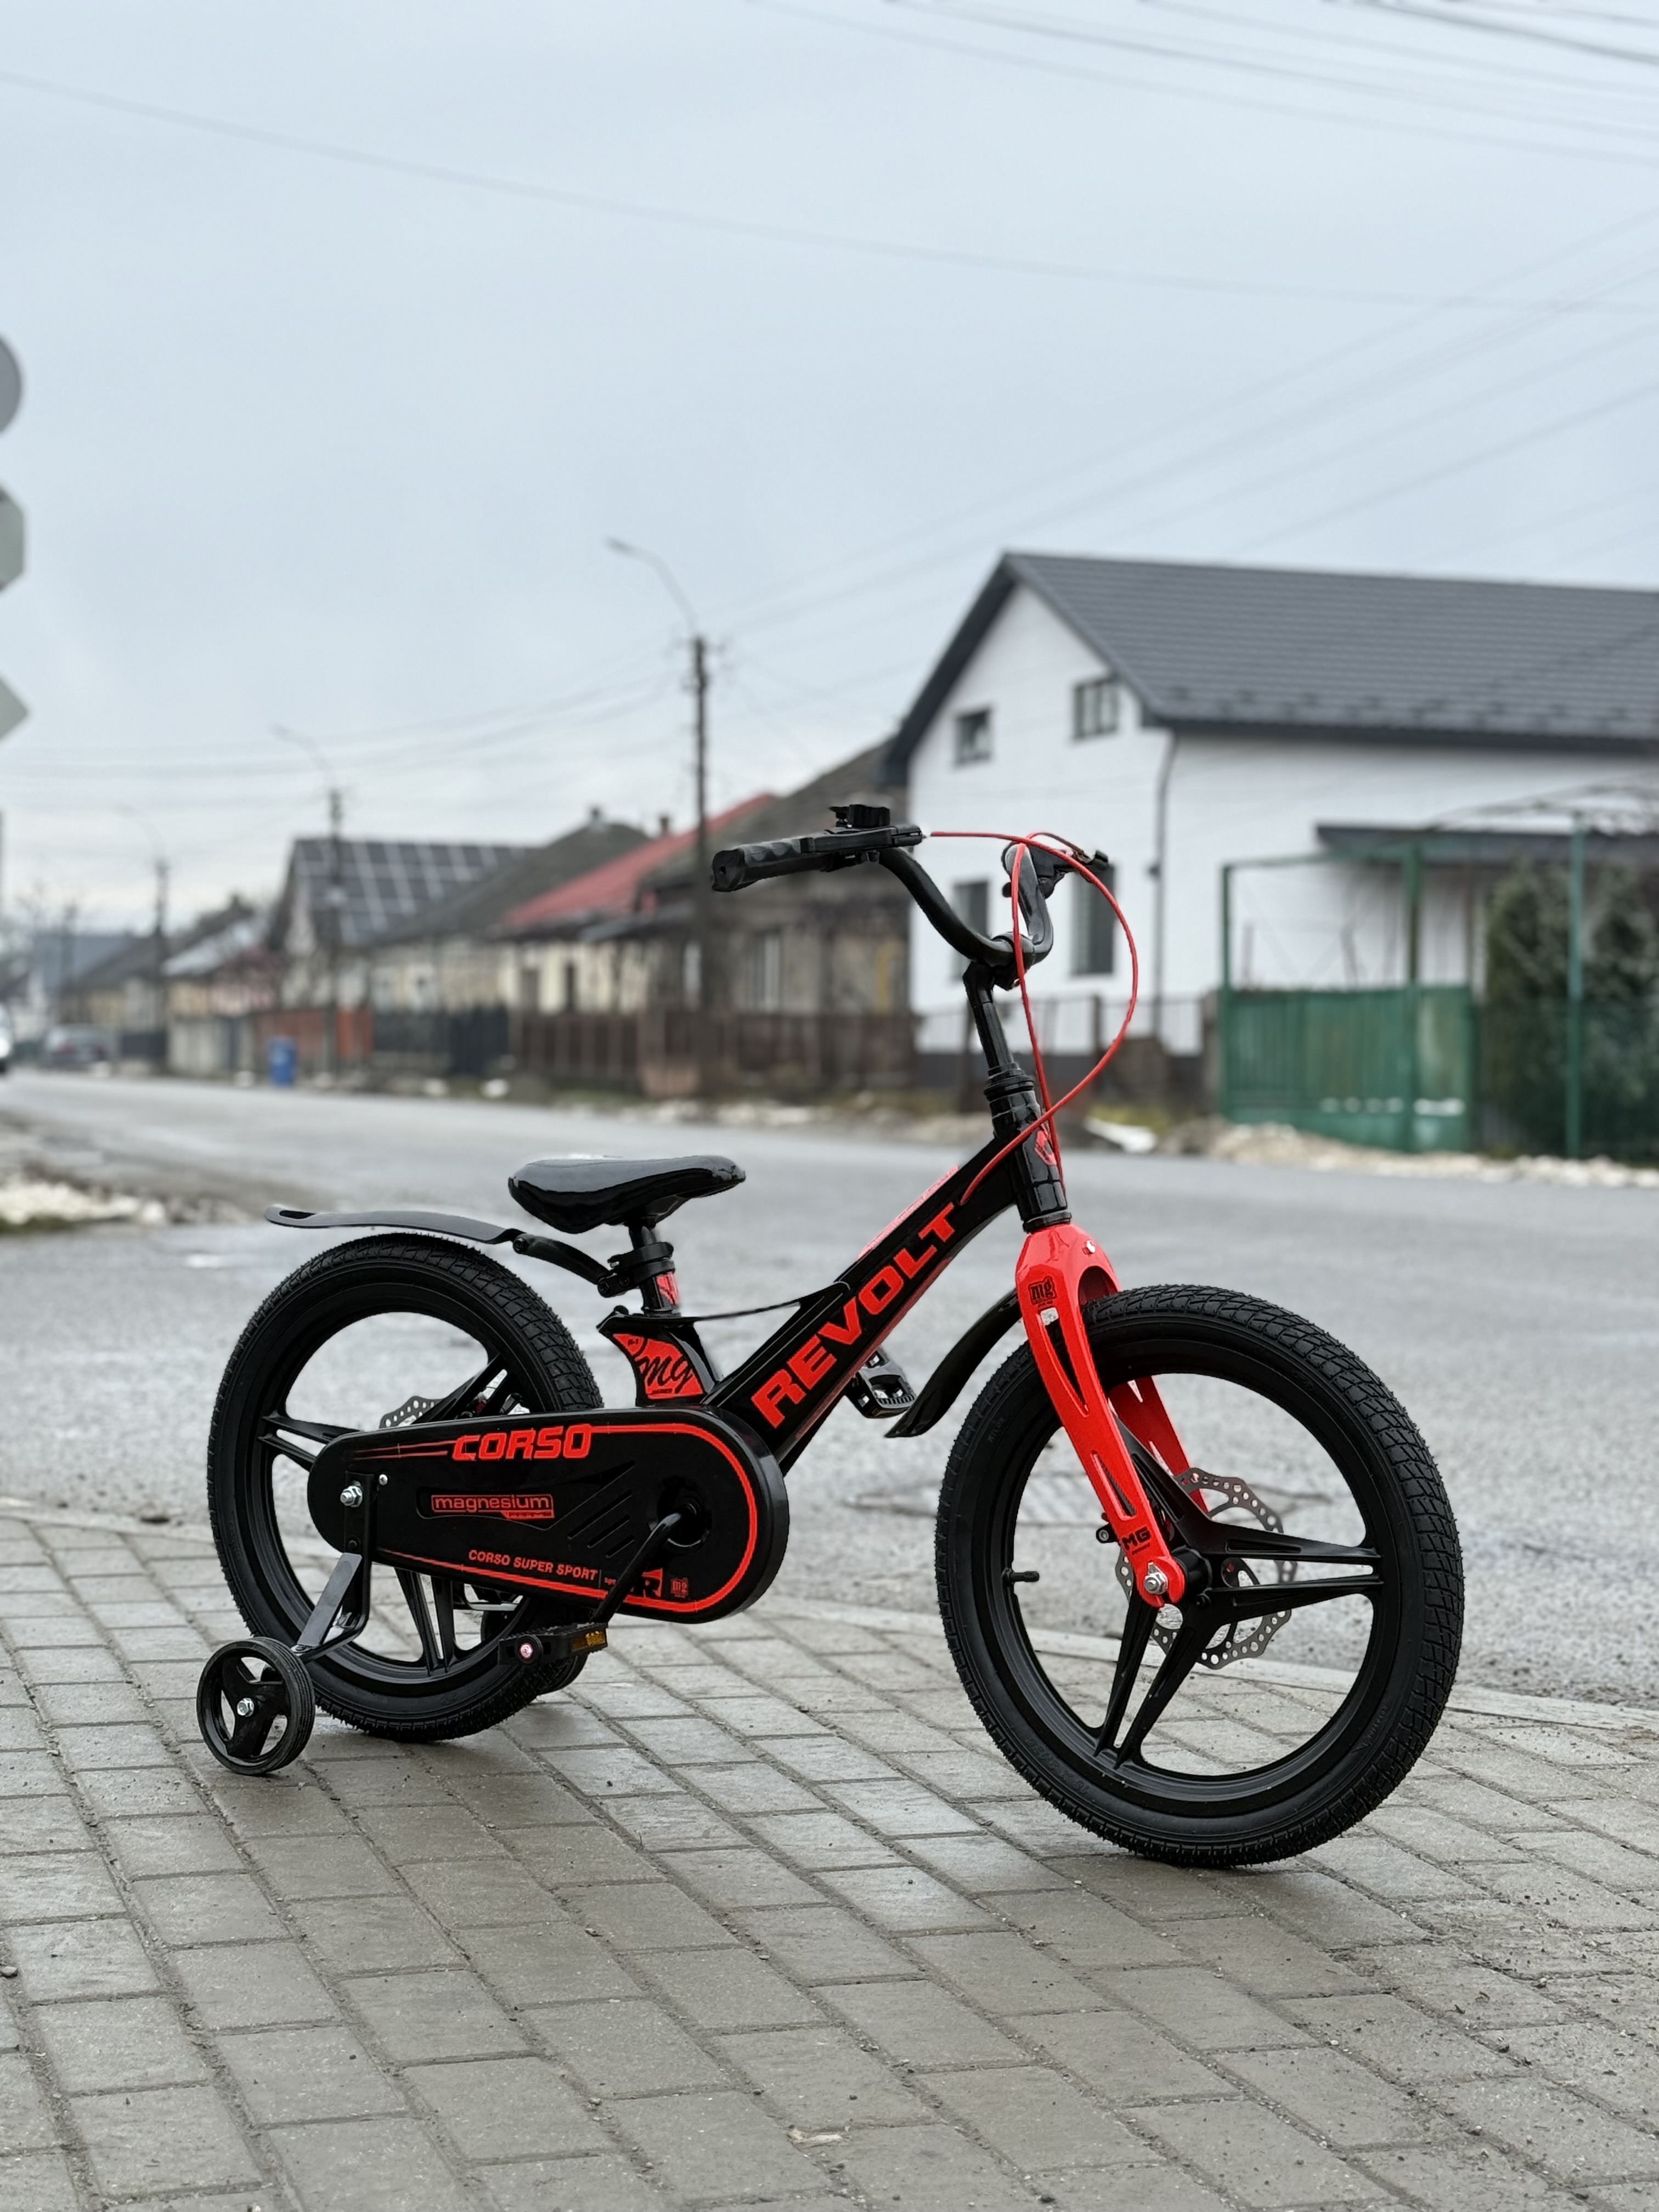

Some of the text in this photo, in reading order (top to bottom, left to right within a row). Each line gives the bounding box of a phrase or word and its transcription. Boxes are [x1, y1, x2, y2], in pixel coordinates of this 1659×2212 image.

[751, 1203, 955, 1428] REVOLT
[452, 1424, 591, 1460] CORSO
[435, 1495, 549, 1513] magnesium
[1121, 1526, 1151, 1550] MG
[469, 1549, 599, 1581] CORSO SUPER SPORT
